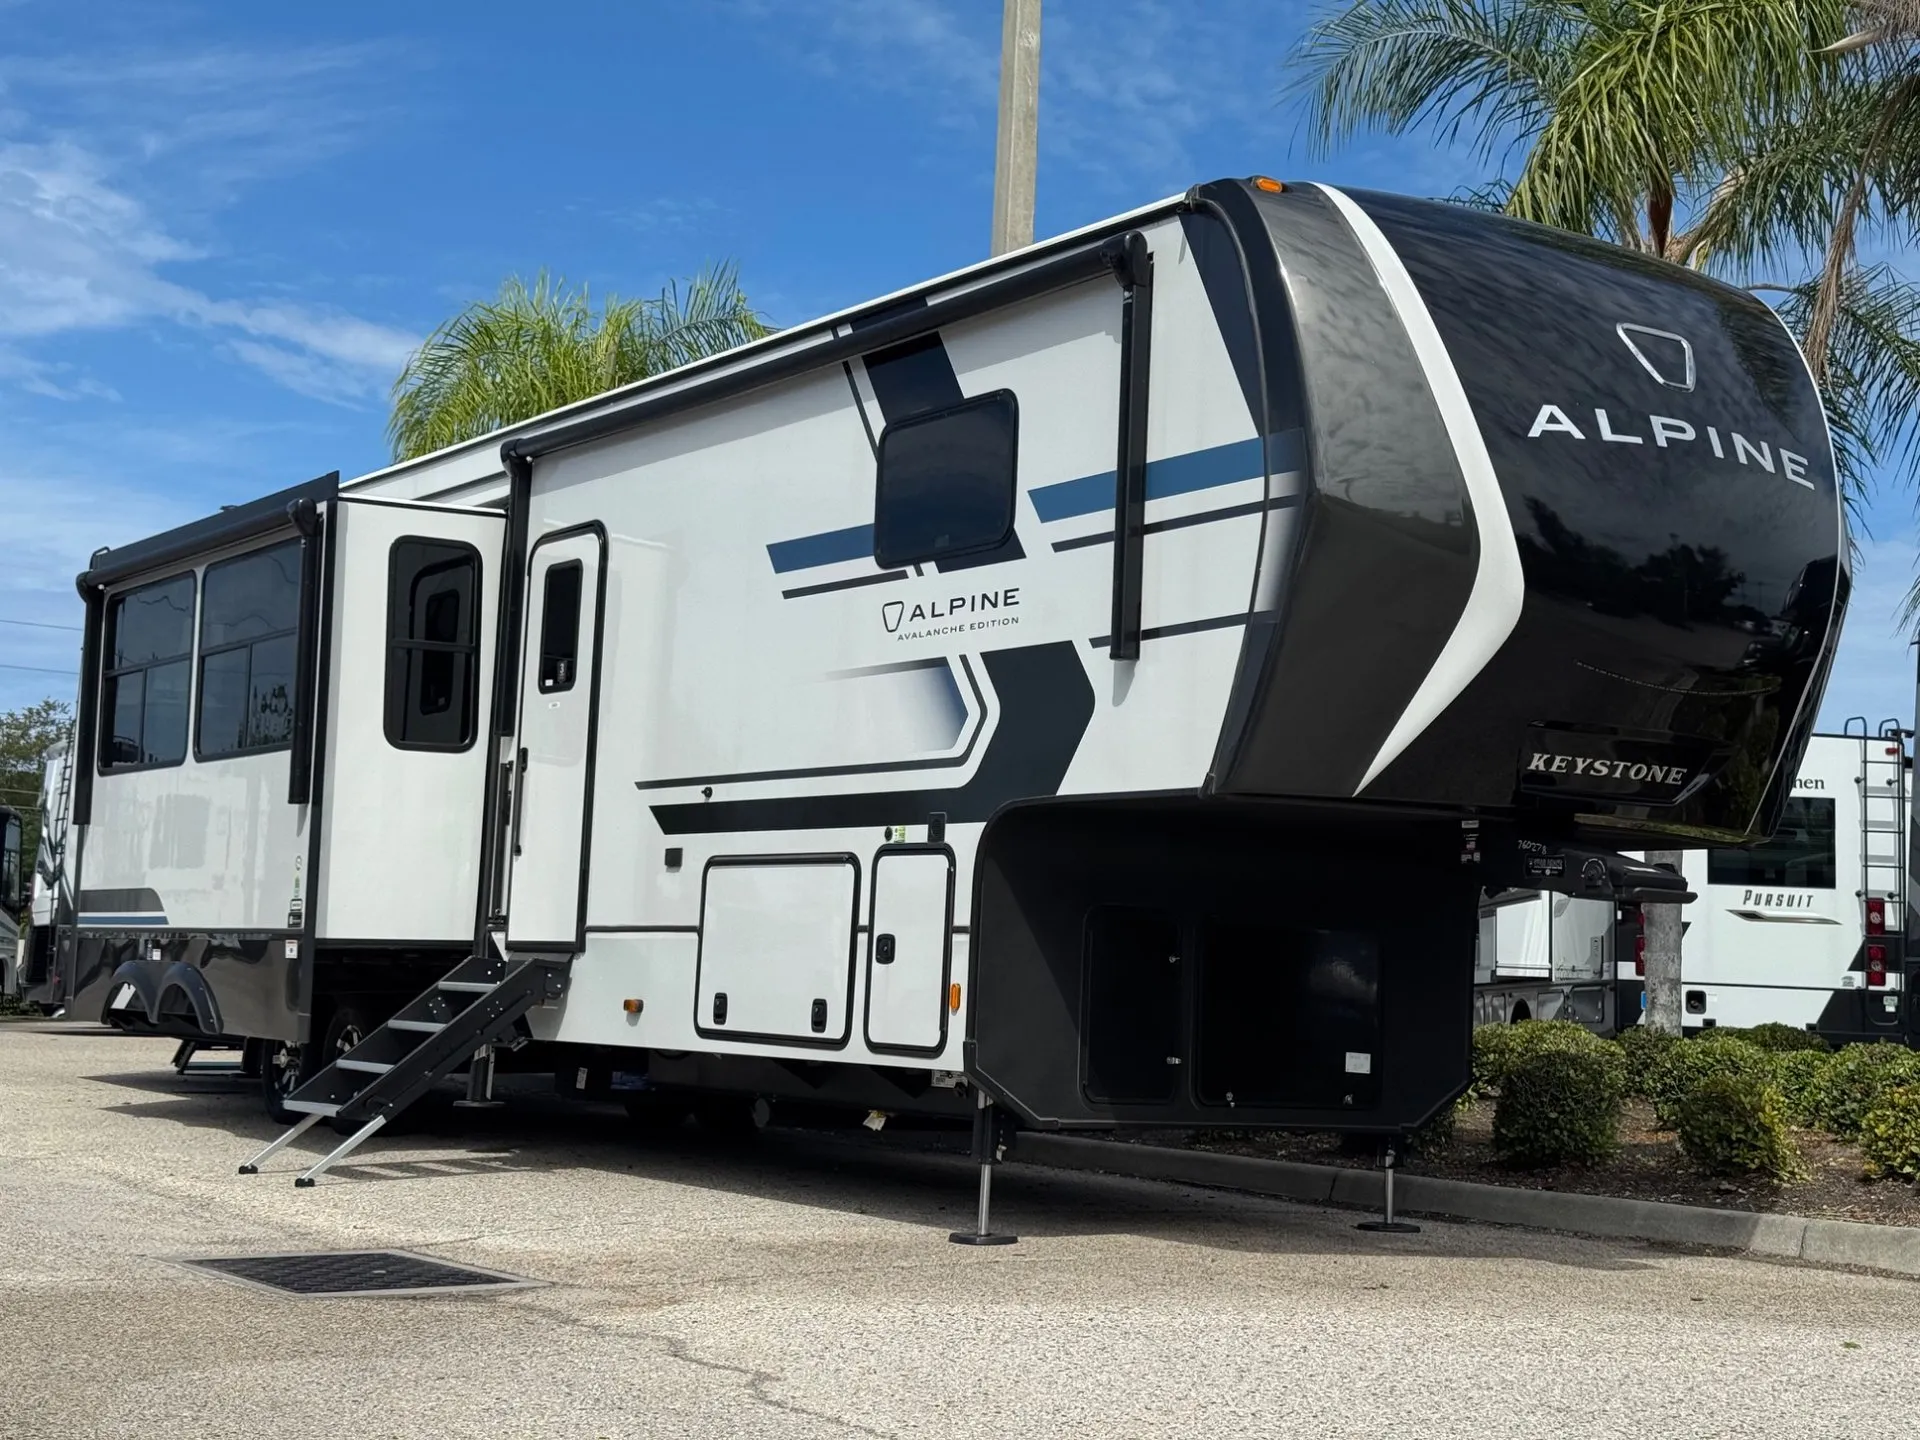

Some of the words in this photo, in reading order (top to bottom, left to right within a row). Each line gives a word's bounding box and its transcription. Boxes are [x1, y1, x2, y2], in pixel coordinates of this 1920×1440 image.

[1527, 403, 1815, 491] ALPINE
[909, 587, 1020, 623] ALPINE
[896, 624, 966, 642] AVALANCHE
[969, 616, 1020, 631] EDITION
[1527, 752, 1688, 786] KEYSTONE
[1742, 889, 1814, 908] PURSUIT
